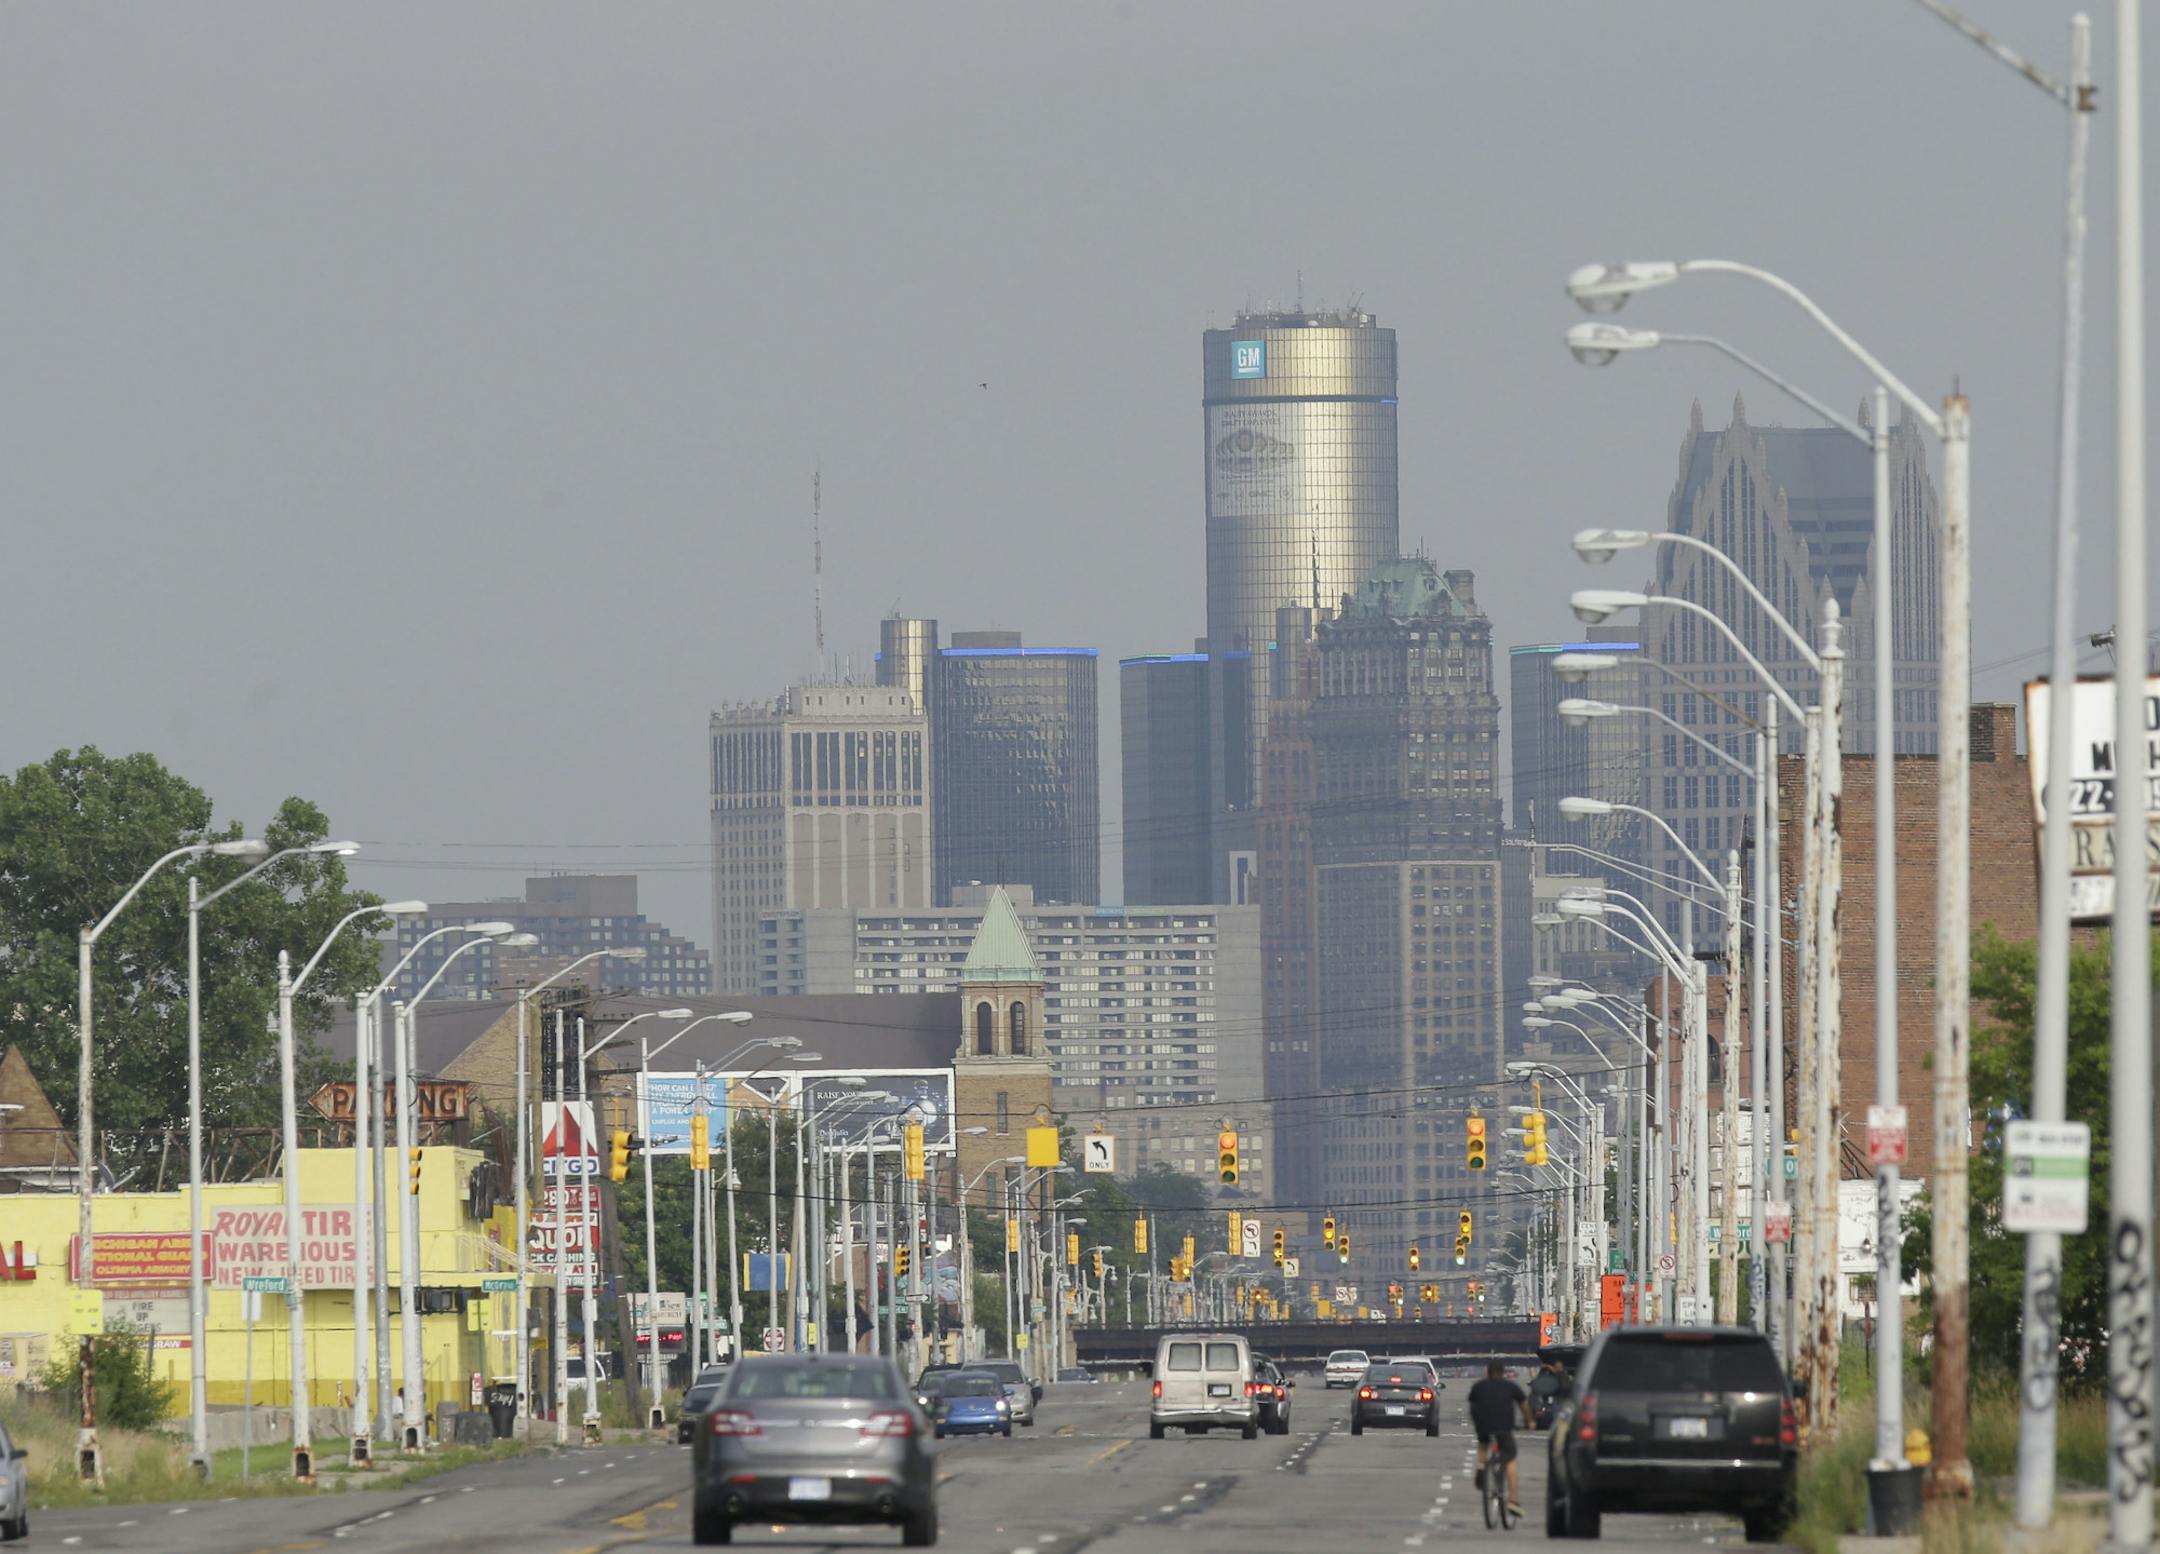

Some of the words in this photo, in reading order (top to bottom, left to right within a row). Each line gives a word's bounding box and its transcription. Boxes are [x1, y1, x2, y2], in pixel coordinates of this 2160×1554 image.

[1238, 347, 1259, 366] GM
[1089, 1161, 1110, 1169] ONLY
[246, 1280, 285, 1291] Wreford
